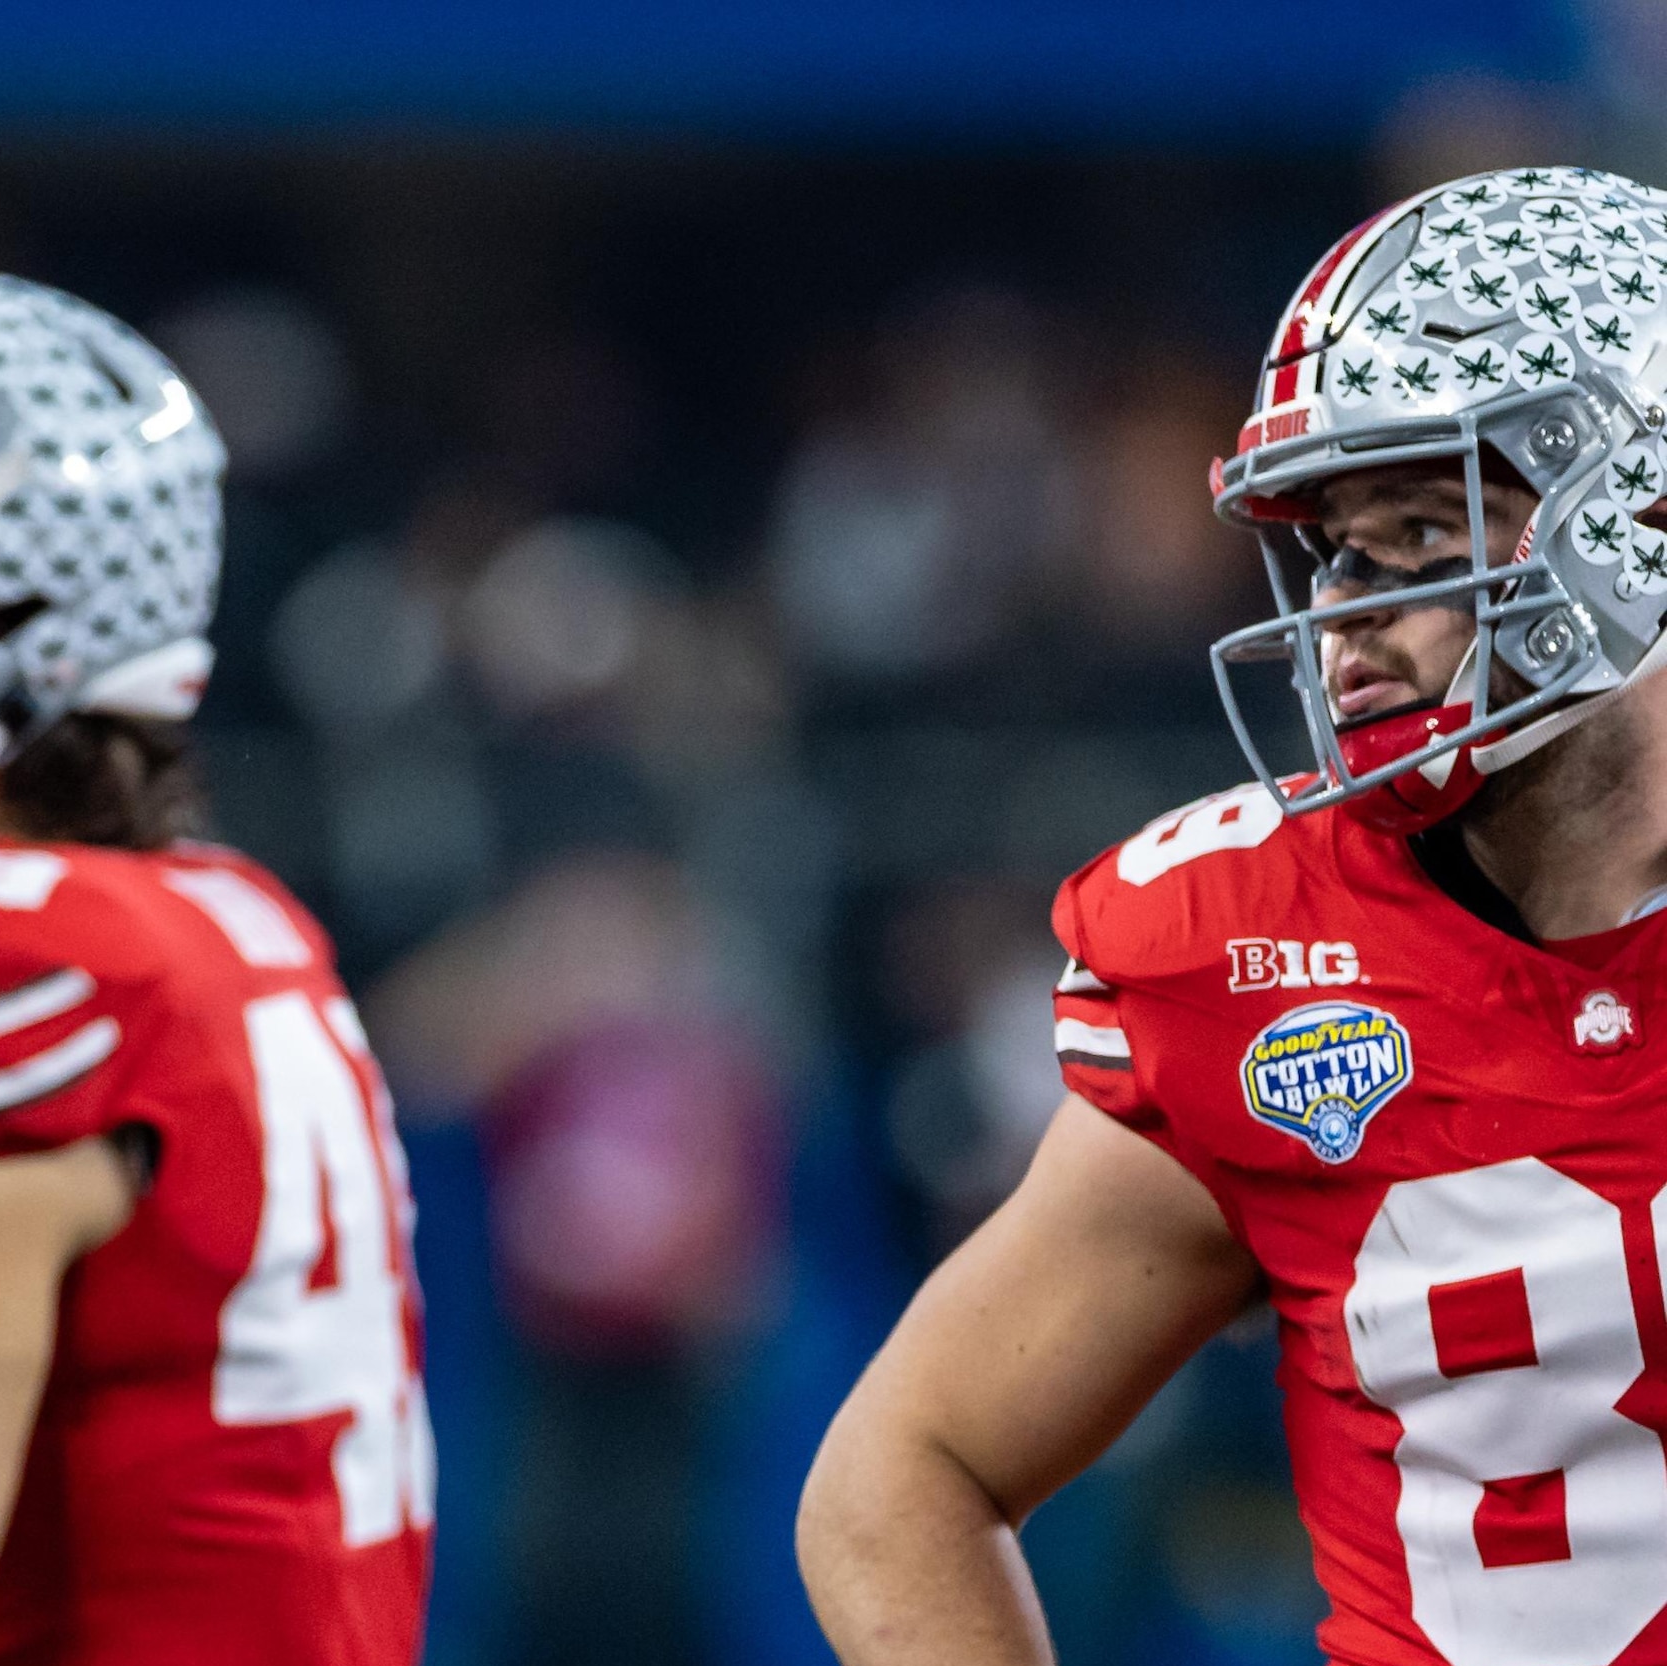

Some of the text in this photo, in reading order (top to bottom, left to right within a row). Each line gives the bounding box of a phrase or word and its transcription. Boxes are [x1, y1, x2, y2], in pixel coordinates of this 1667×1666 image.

[1254, 1018, 1387, 1061] GOODYEAR
[1255, 1036, 1396, 1109] COTTON
[1284, 1071, 1371, 1114] BOWL
